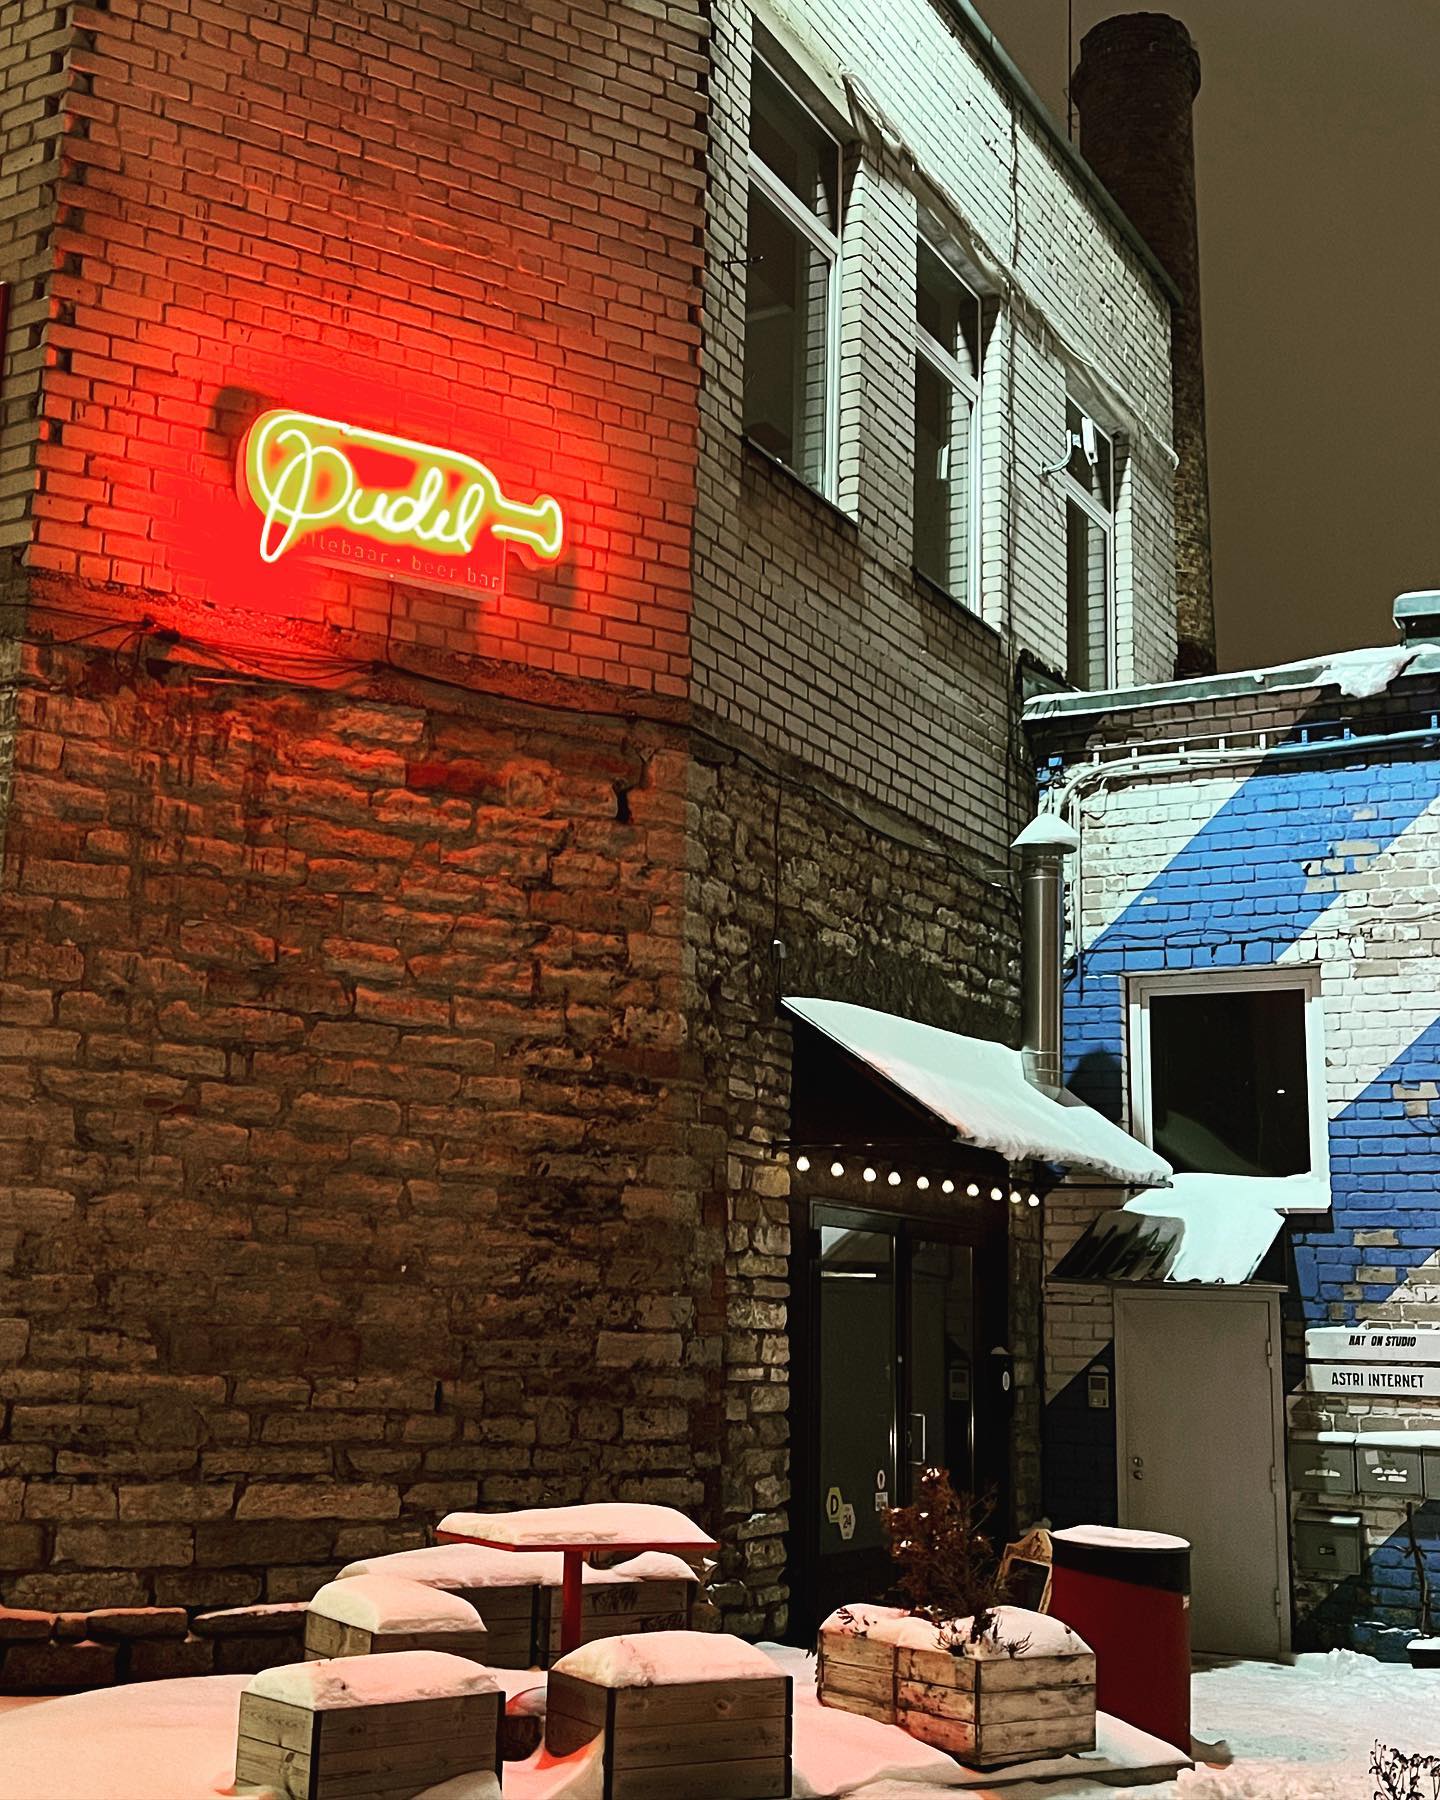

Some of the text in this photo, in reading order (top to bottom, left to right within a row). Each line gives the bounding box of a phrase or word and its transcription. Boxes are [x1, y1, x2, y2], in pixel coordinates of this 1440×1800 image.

[259, 428, 485, 563] Pudel
[412, 555, 457, 578] beer
[467, 567, 500, 588] bar
[1371, 1335, 1384, 1347] ON
[1385, 1336, 1417, 1347] STUDIO
[1331, 1372, 1425, 1389] ASTRI INTERNET
